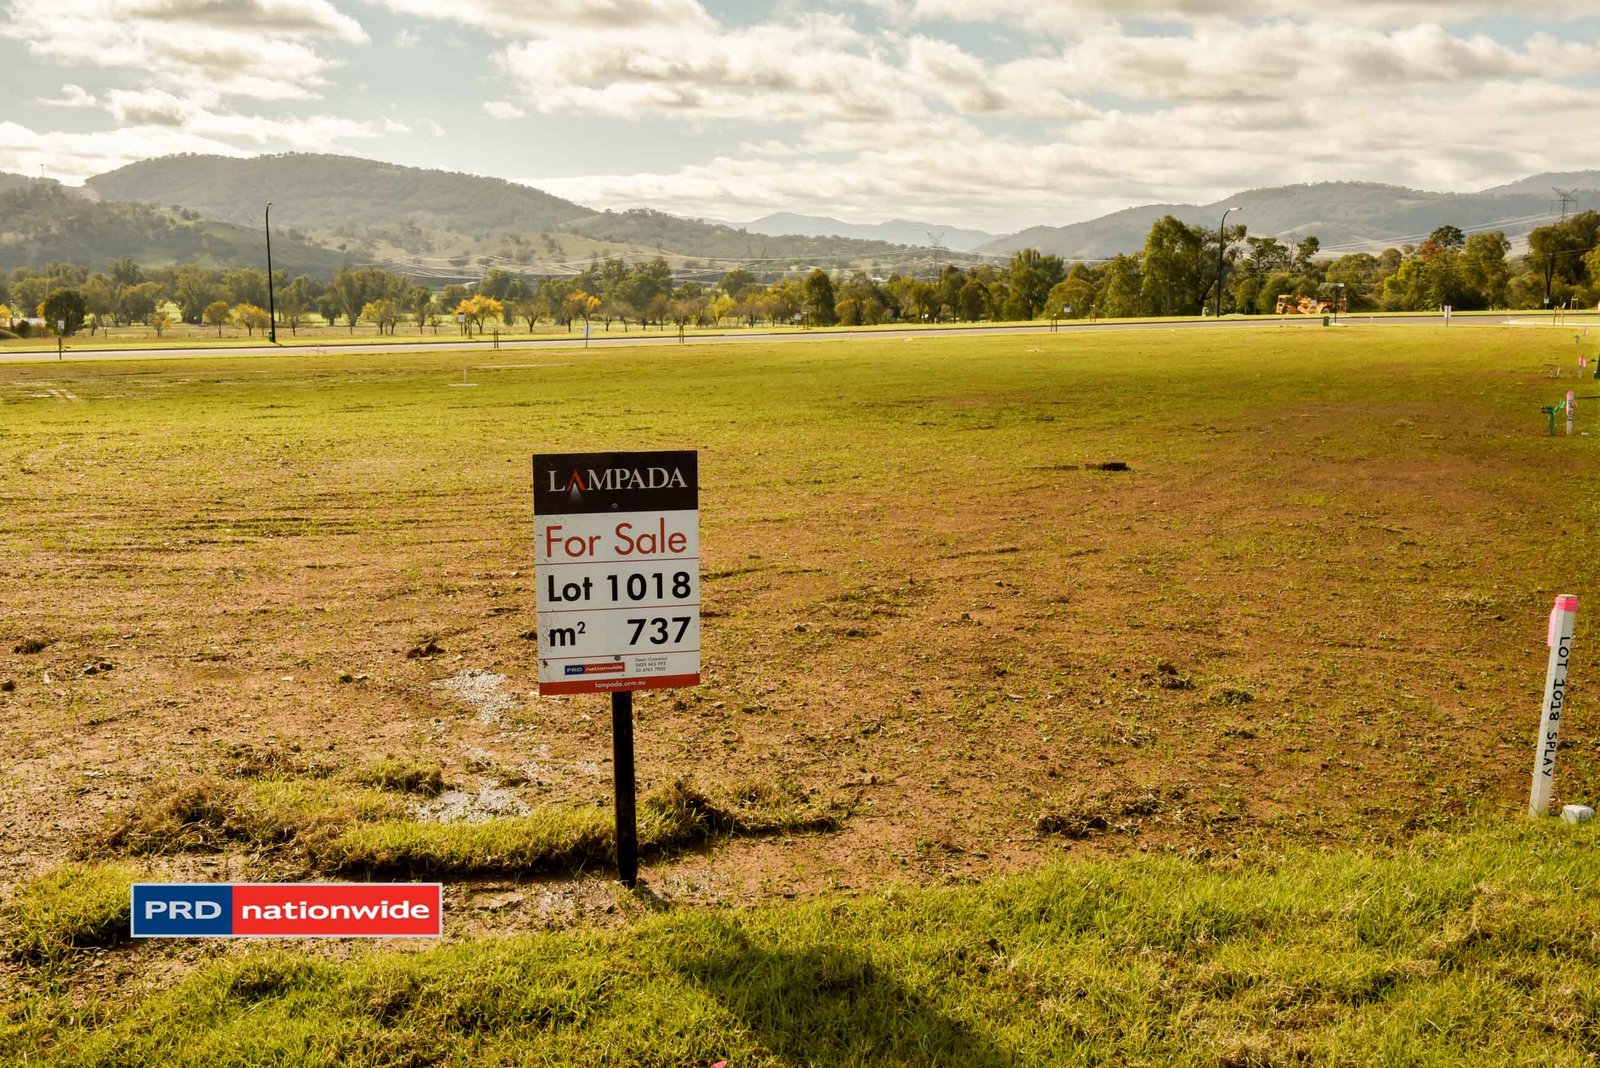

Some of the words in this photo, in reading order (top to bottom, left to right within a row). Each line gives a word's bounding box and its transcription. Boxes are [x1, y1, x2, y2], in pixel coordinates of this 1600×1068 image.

[547, 466, 688, 492] LAMPADA
[545, 525, 602, 558] For
[614, 517, 687, 556] Sale
[547, 574, 593, 602] Lot
[606, 571, 692, 601] 1018
[627, 616, 691, 646] 737
[1556, 636, 1571, 670] LOT
[566, 666, 583, 674] PRD
[585, 664, 624, 672] nationwide
[595, 680, 647, 689] lampada.com.au
[1549, 678, 1565, 722] 1018
[1542, 731, 1557, 777] SPLAY
